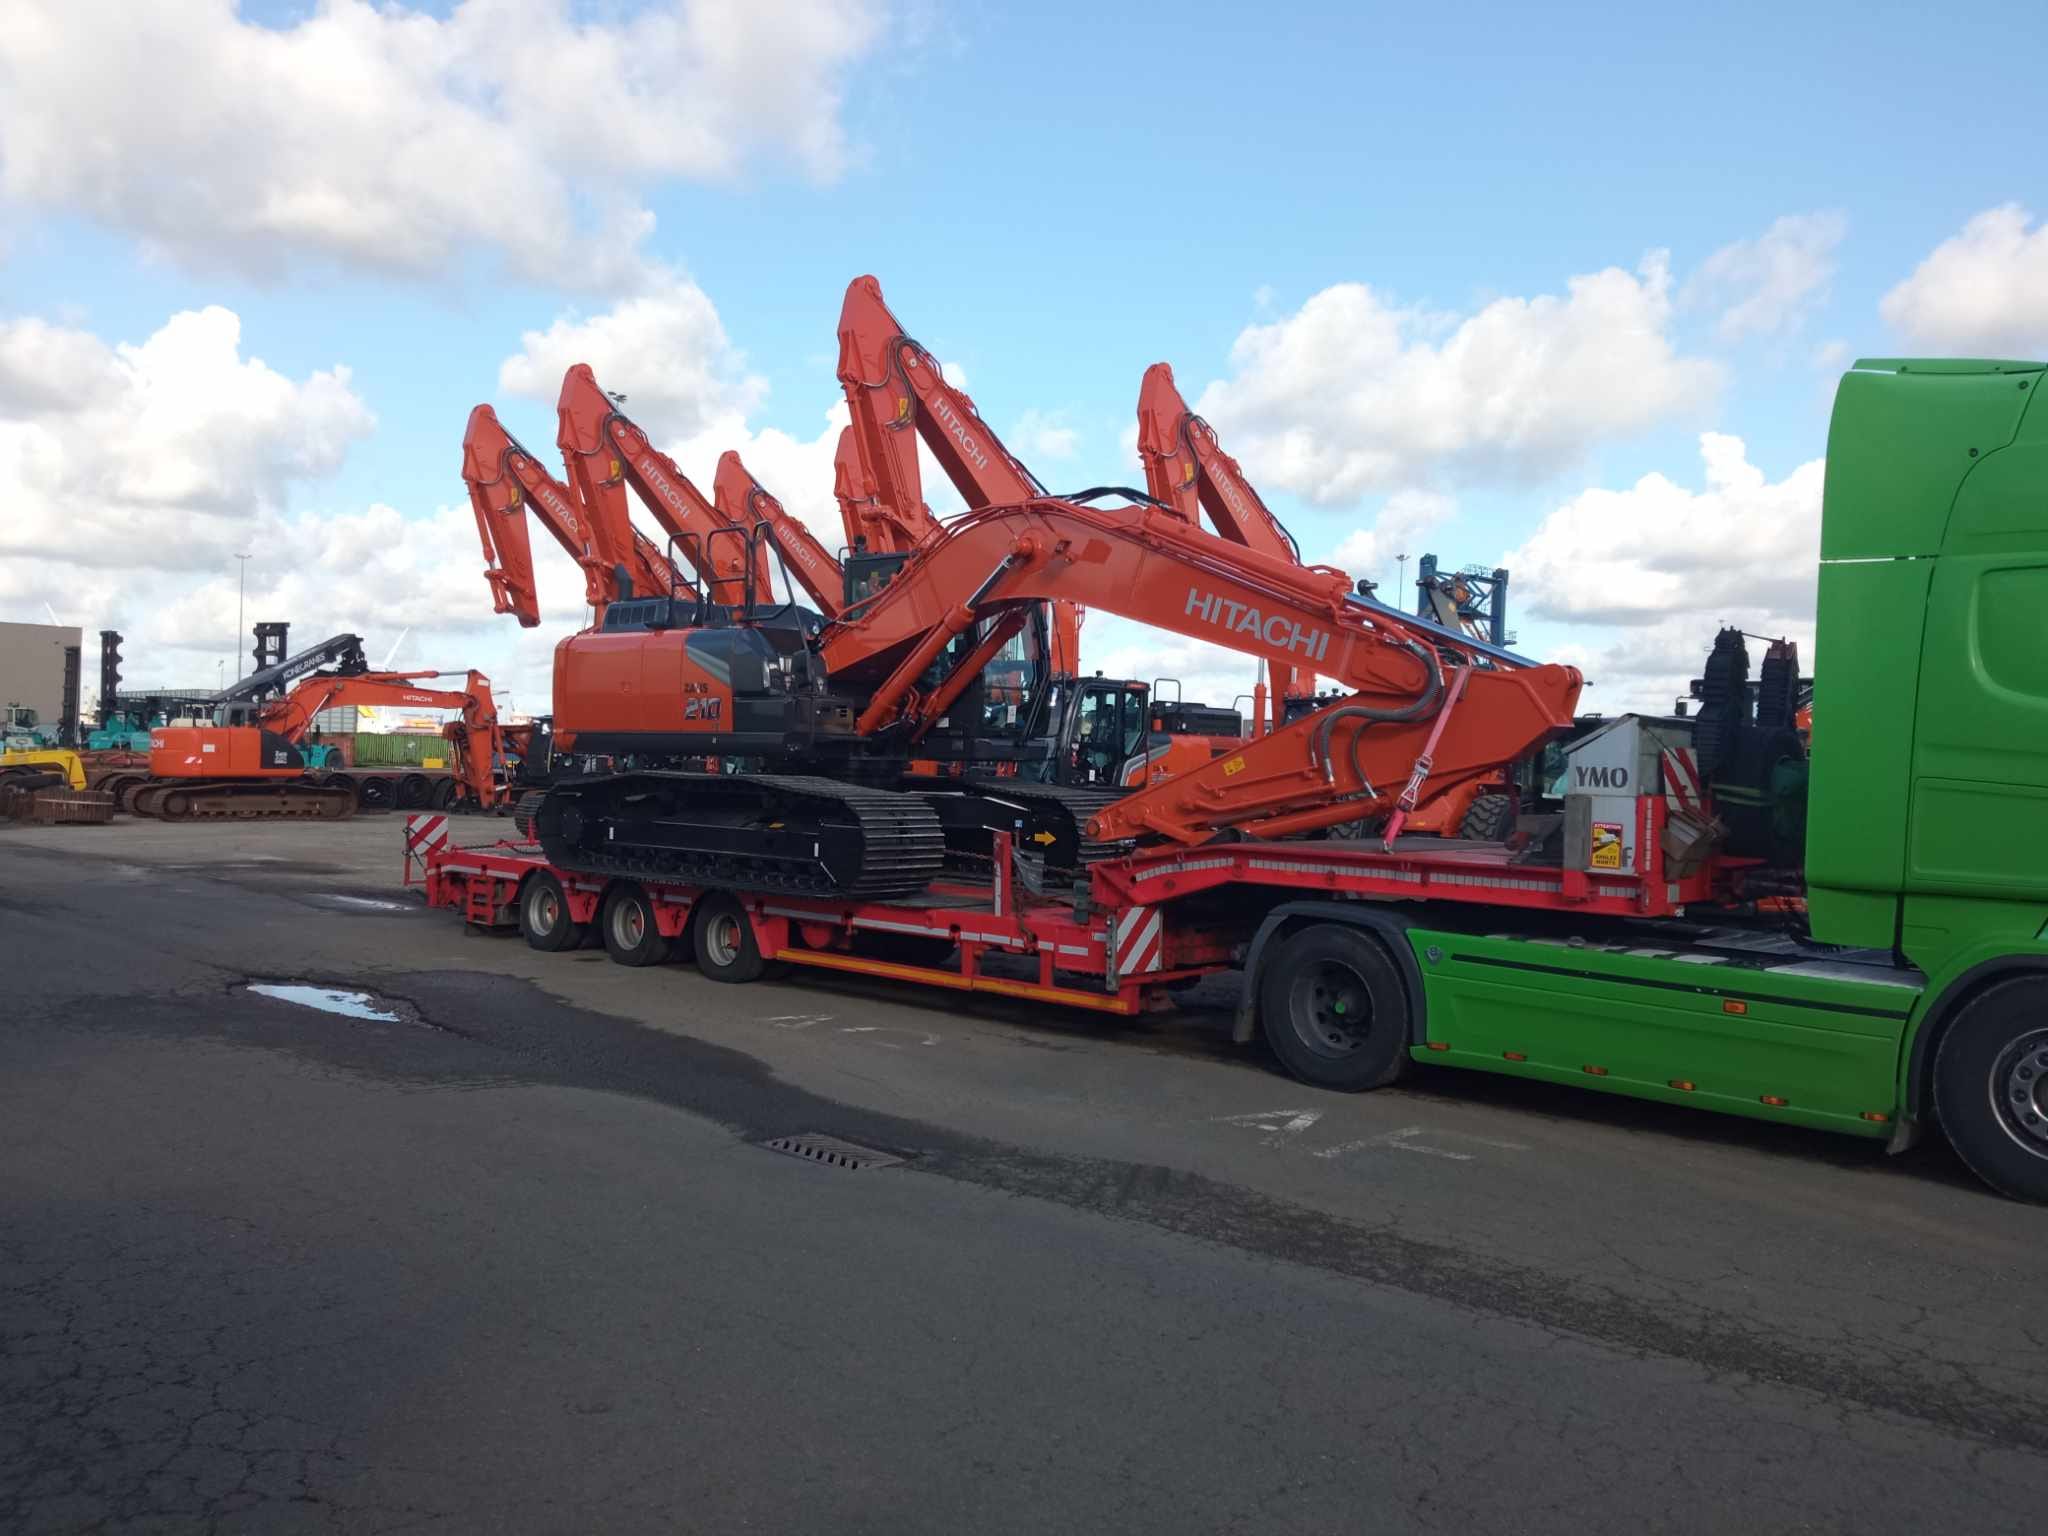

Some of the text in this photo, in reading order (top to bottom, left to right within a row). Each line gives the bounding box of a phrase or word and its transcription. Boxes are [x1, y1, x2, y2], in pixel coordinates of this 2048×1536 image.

[934, 397, 988, 470] HITACHI
[641, 459, 690, 519] HITACHI
[1210, 462, 1249, 522] HITACHI
[779, 525, 817, 569] HITACHI
[1184, 587, 1330, 662] HITACHI
[402, 694, 433, 703] HITACHI
[684, 697, 721, 720] 210
[1576, 766, 1628, 788] YMO
